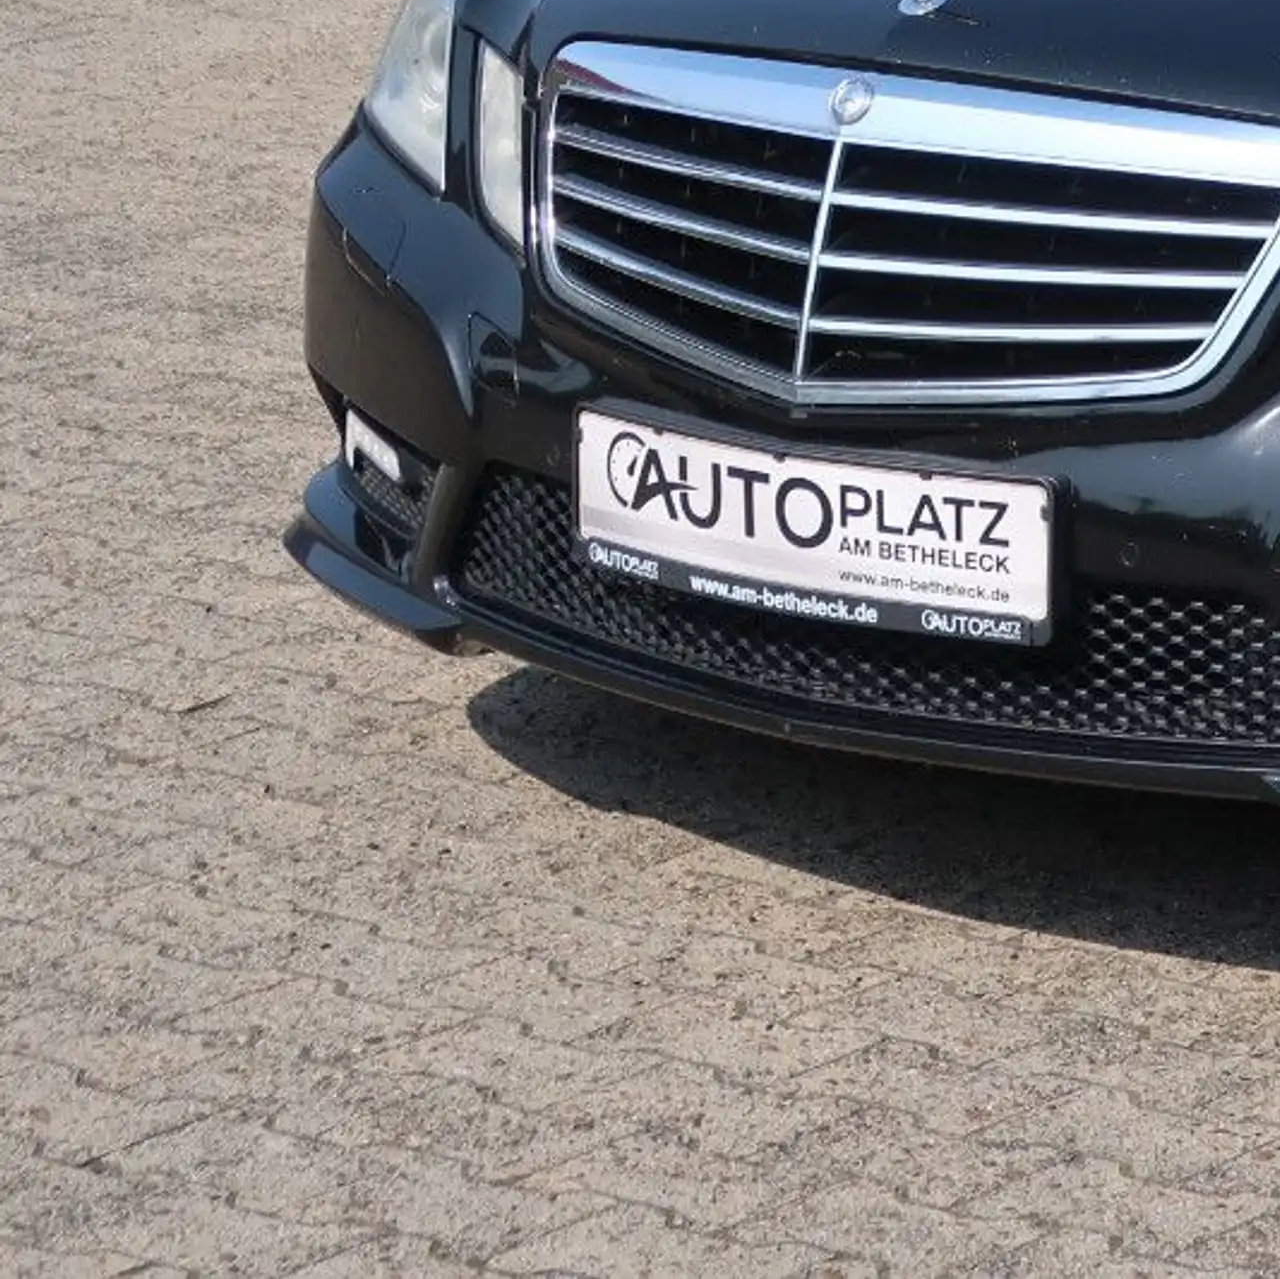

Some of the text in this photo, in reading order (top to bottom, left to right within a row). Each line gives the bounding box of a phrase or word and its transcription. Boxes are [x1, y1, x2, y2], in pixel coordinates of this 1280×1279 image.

[629, 445, 1010, 549] AUTOPLATZ
[839, 536, 1011, 575] AM BETHELECK
[688, 575, 878, 624] www.am-betheleck.de
[838, 569, 1011, 603] www.am-betheleck.de
